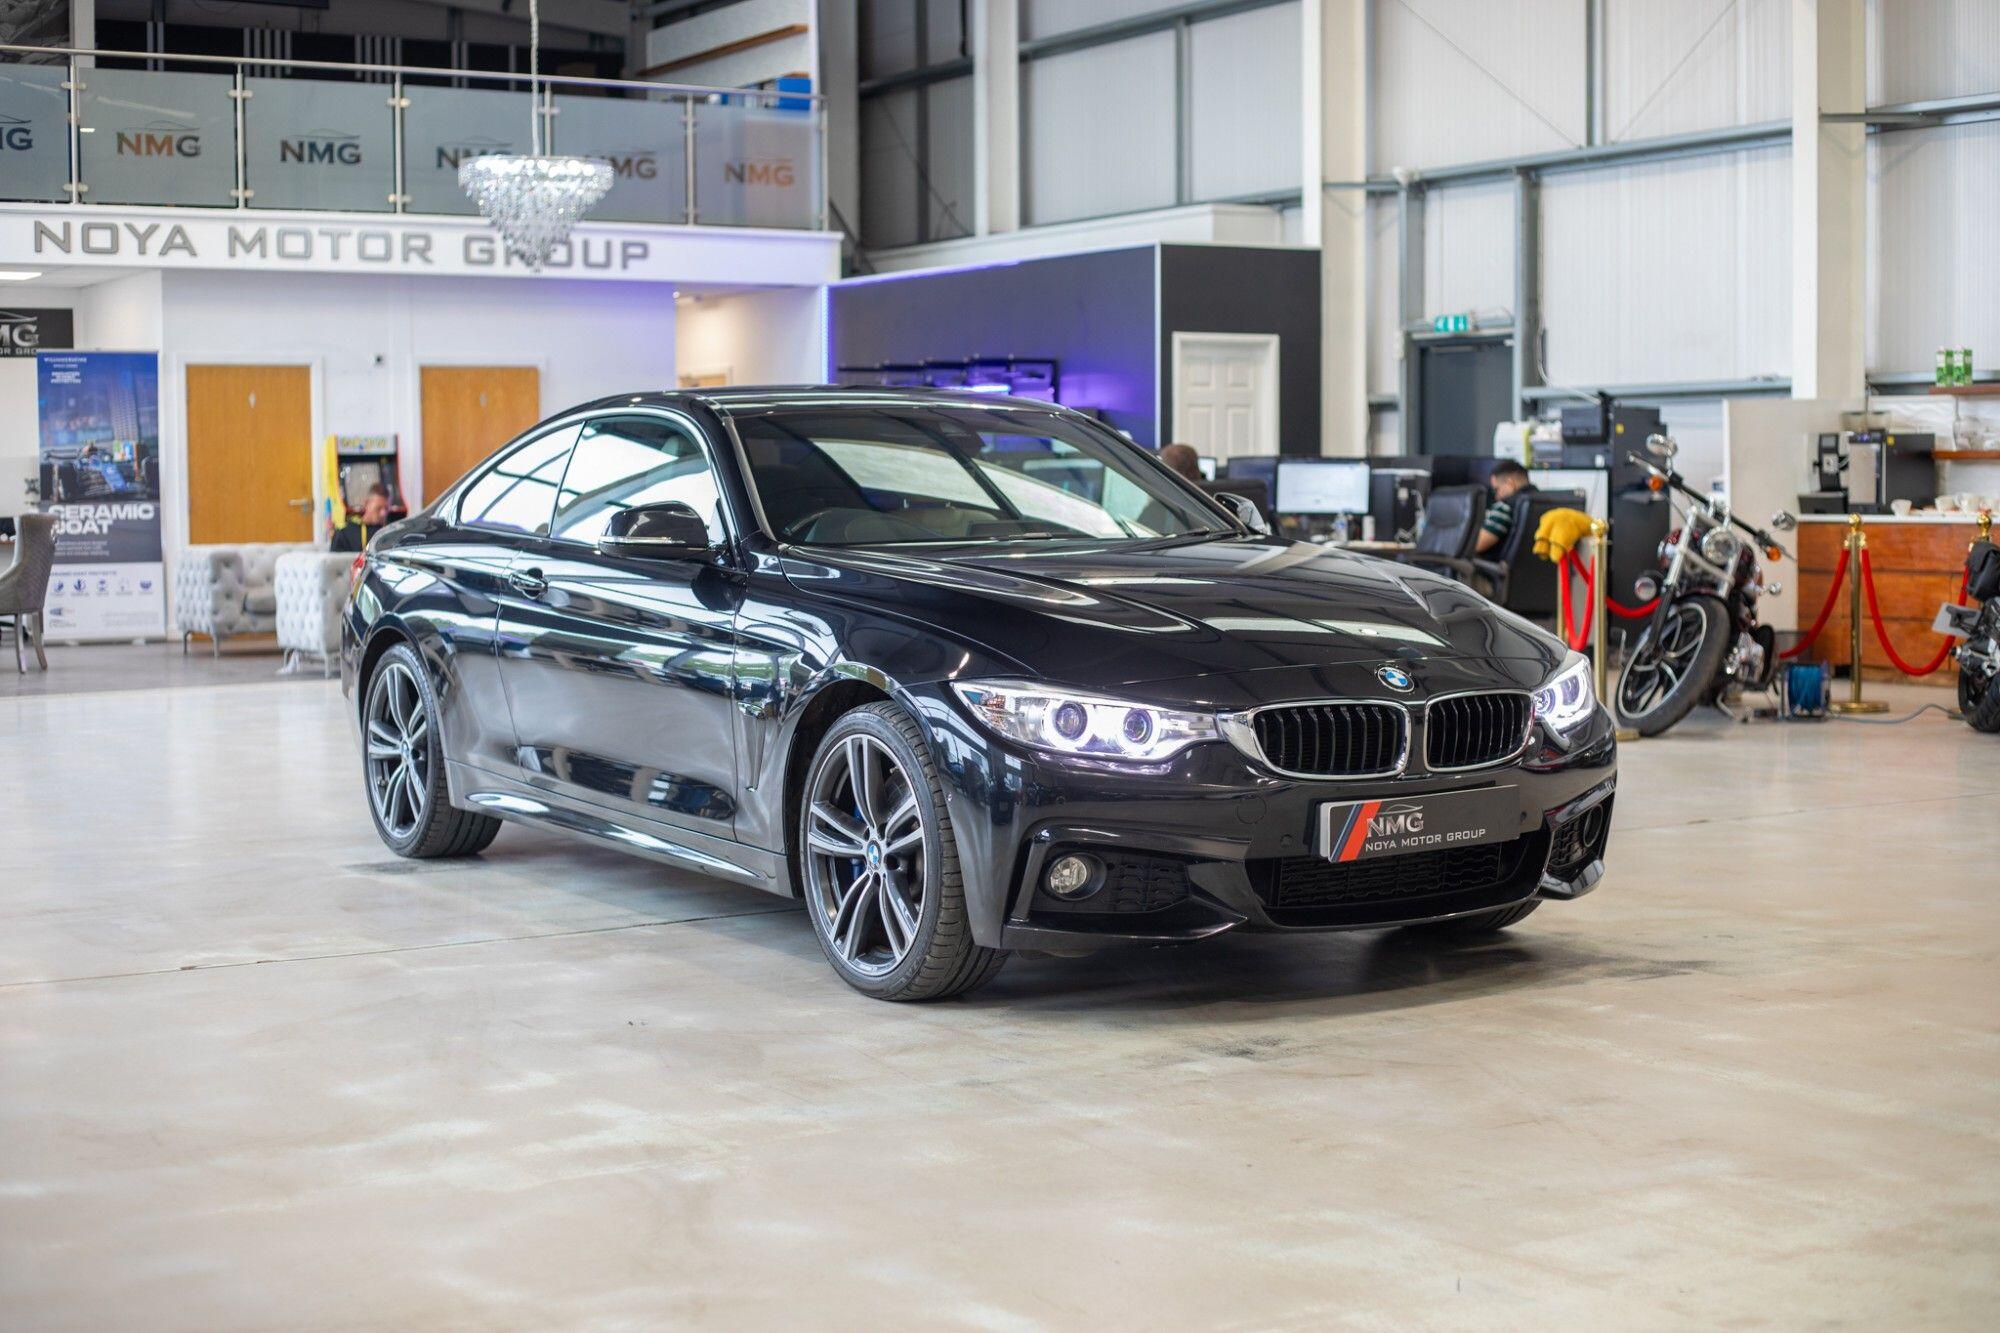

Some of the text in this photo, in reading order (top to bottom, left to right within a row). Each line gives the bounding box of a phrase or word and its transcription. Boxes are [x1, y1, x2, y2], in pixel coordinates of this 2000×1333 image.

[0, 127, 33, 150] G
[116, 131, 201, 157] NMG
[279, 139, 362, 165] NMG
[584, 156, 657, 179] MG
[724, 162, 795, 187] NMG
[34, 220, 198, 257] NOYA
[227, 225, 433, 264] MOTOR
[48, 503, 155, 520] CERAMIC
[1366, 812, 1424, 838] NMG
[1365, 828, 1486, 852] NOYA MOTOR GROUP
